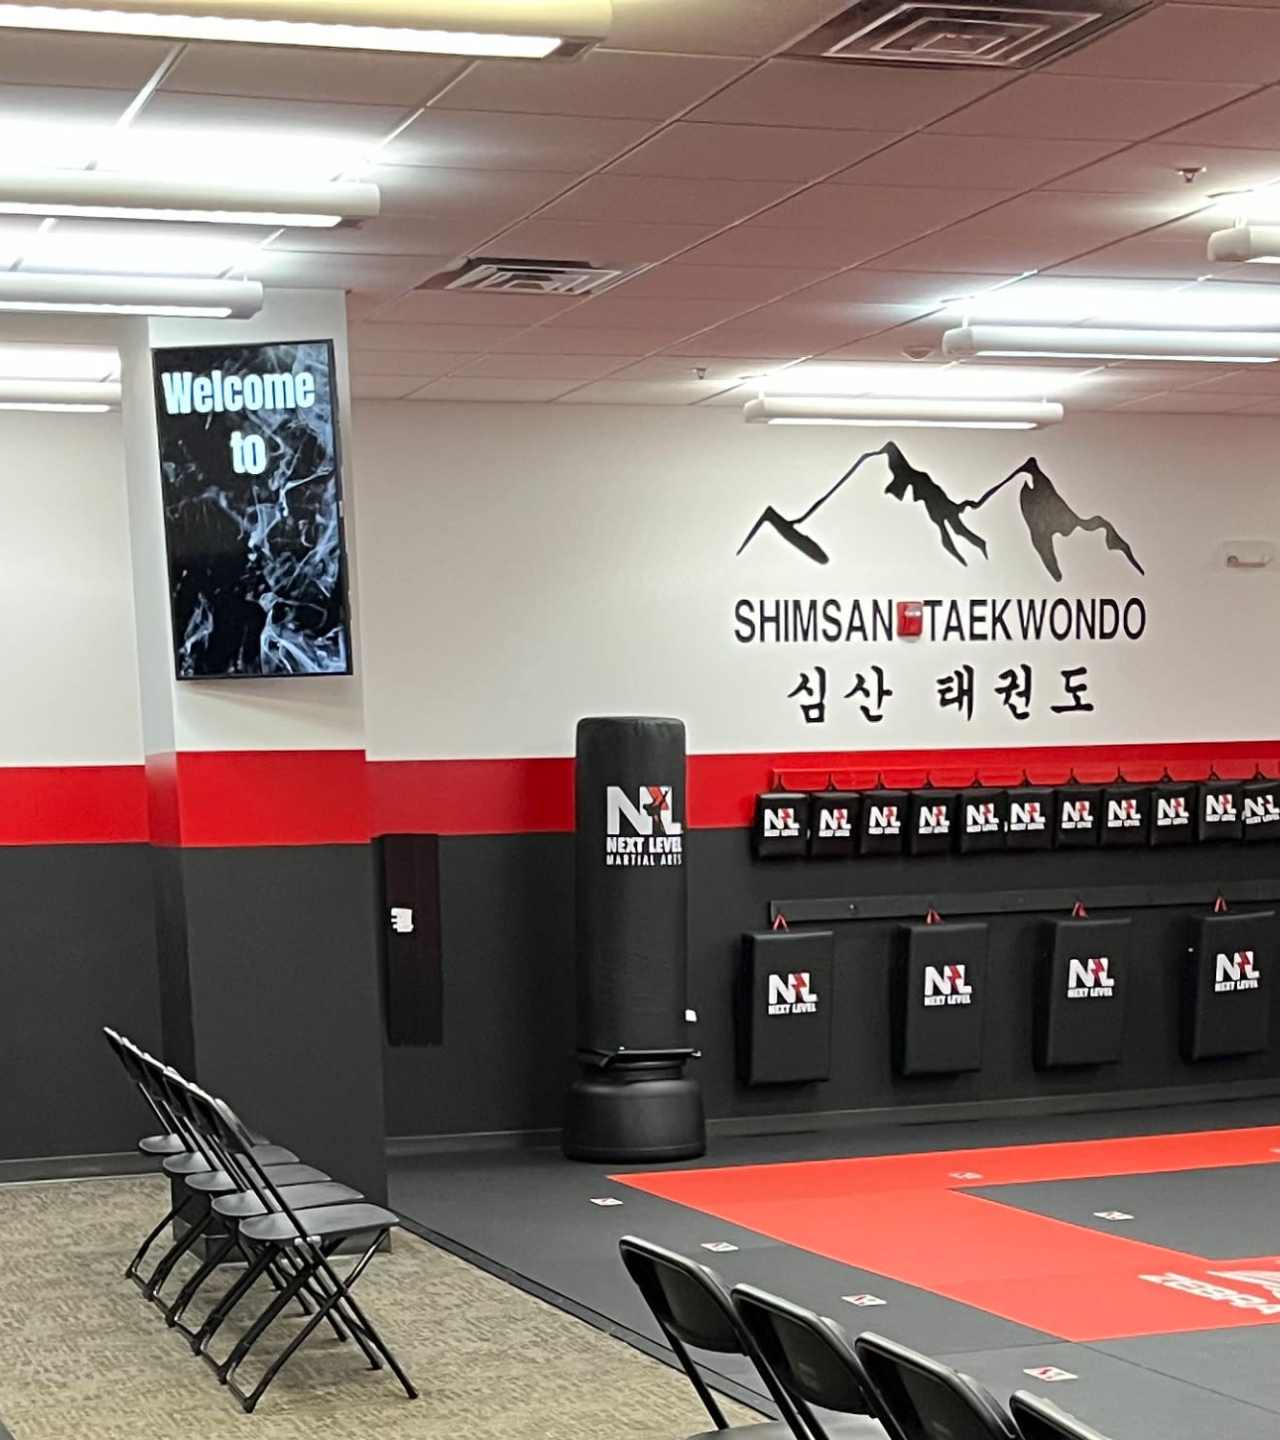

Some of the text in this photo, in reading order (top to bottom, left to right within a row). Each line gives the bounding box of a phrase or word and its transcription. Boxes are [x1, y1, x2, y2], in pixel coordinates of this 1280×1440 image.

[162, 370, 315, 414] Welcome
[230, 431, 266, 475] to
[734, 597, 1146, 643] SHIMSAN TAEKWONDO
[787, 663, 1094, 723] 심산 태권도
[606, 836, 682, 853] NEXT LEVEL
[606, 854, 655, 866] MARTIAL
